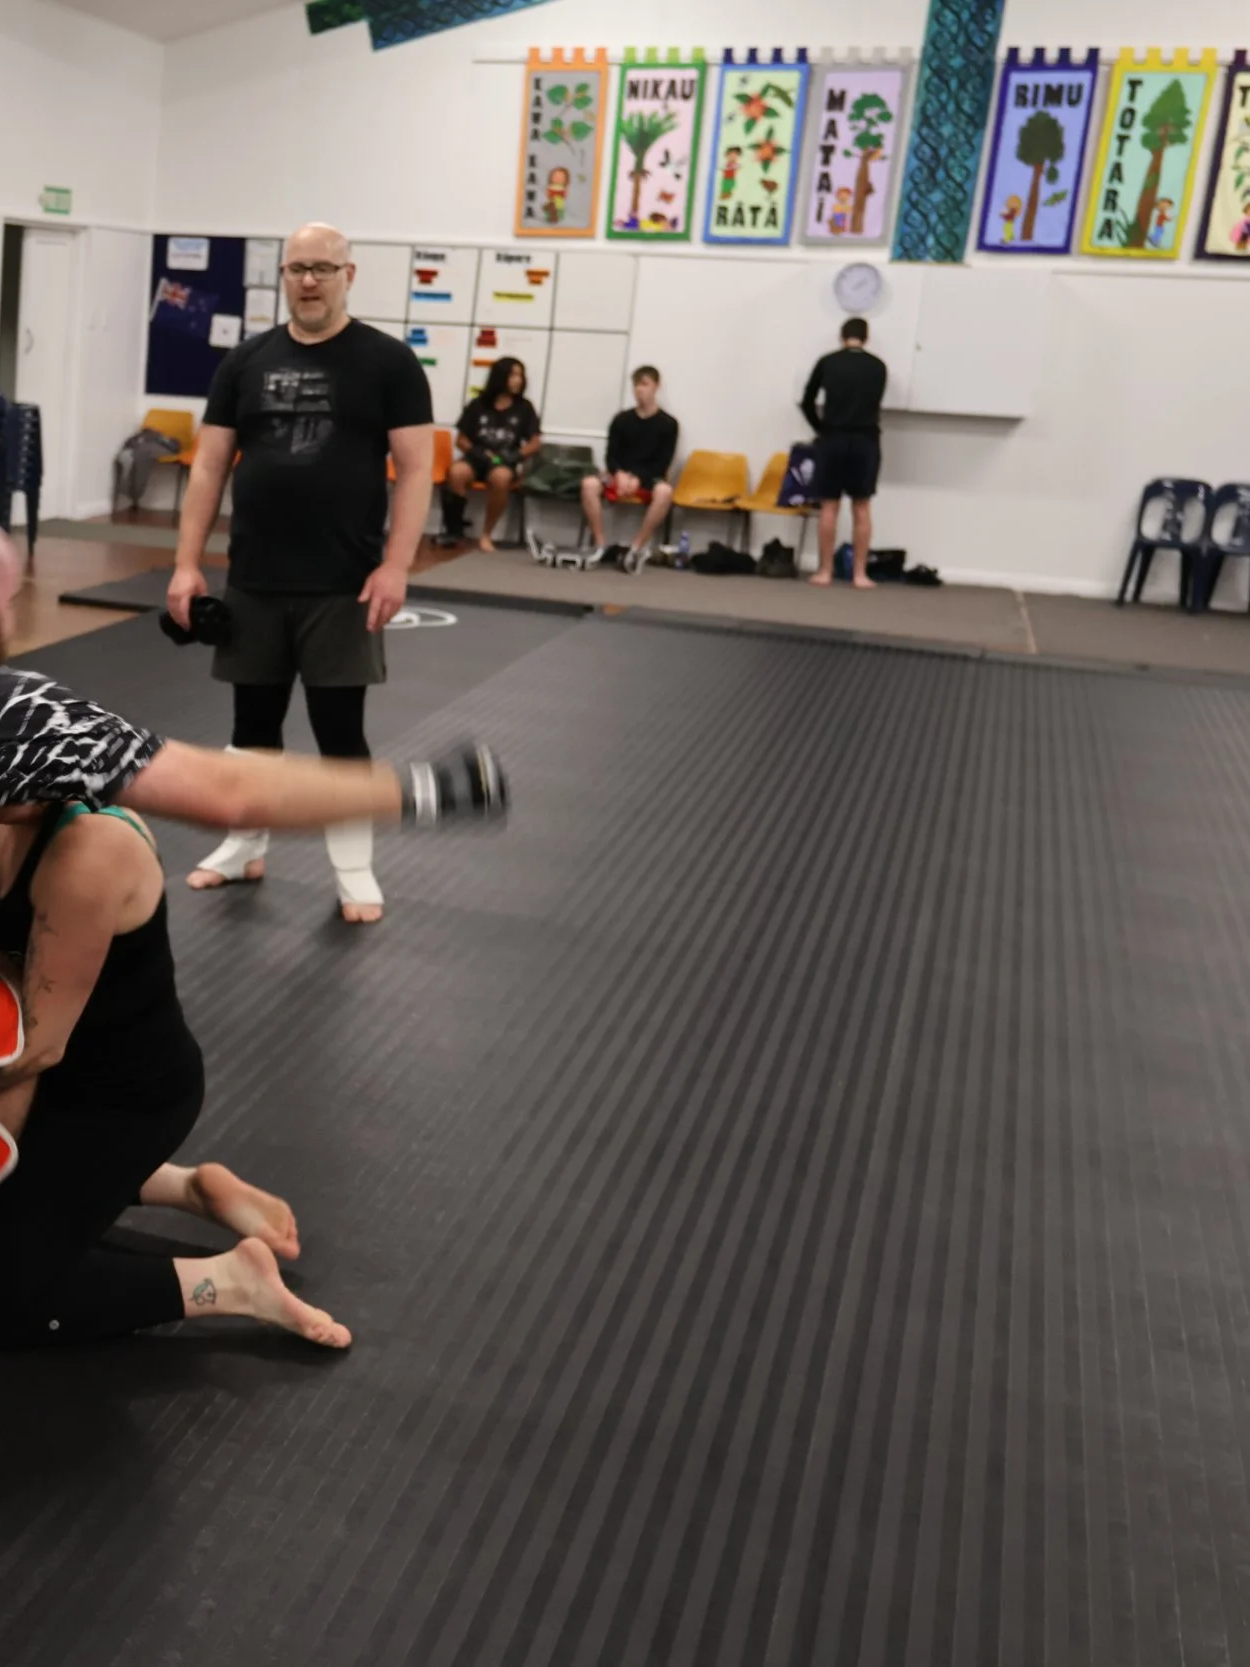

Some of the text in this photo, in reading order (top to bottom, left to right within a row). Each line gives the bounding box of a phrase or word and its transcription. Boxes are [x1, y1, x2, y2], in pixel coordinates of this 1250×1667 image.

[628, 79, 695, 100] NIKAU
[1015, 83, 1083, 107] RIMU
[1098, 79, 1143, 240] TOTARA
